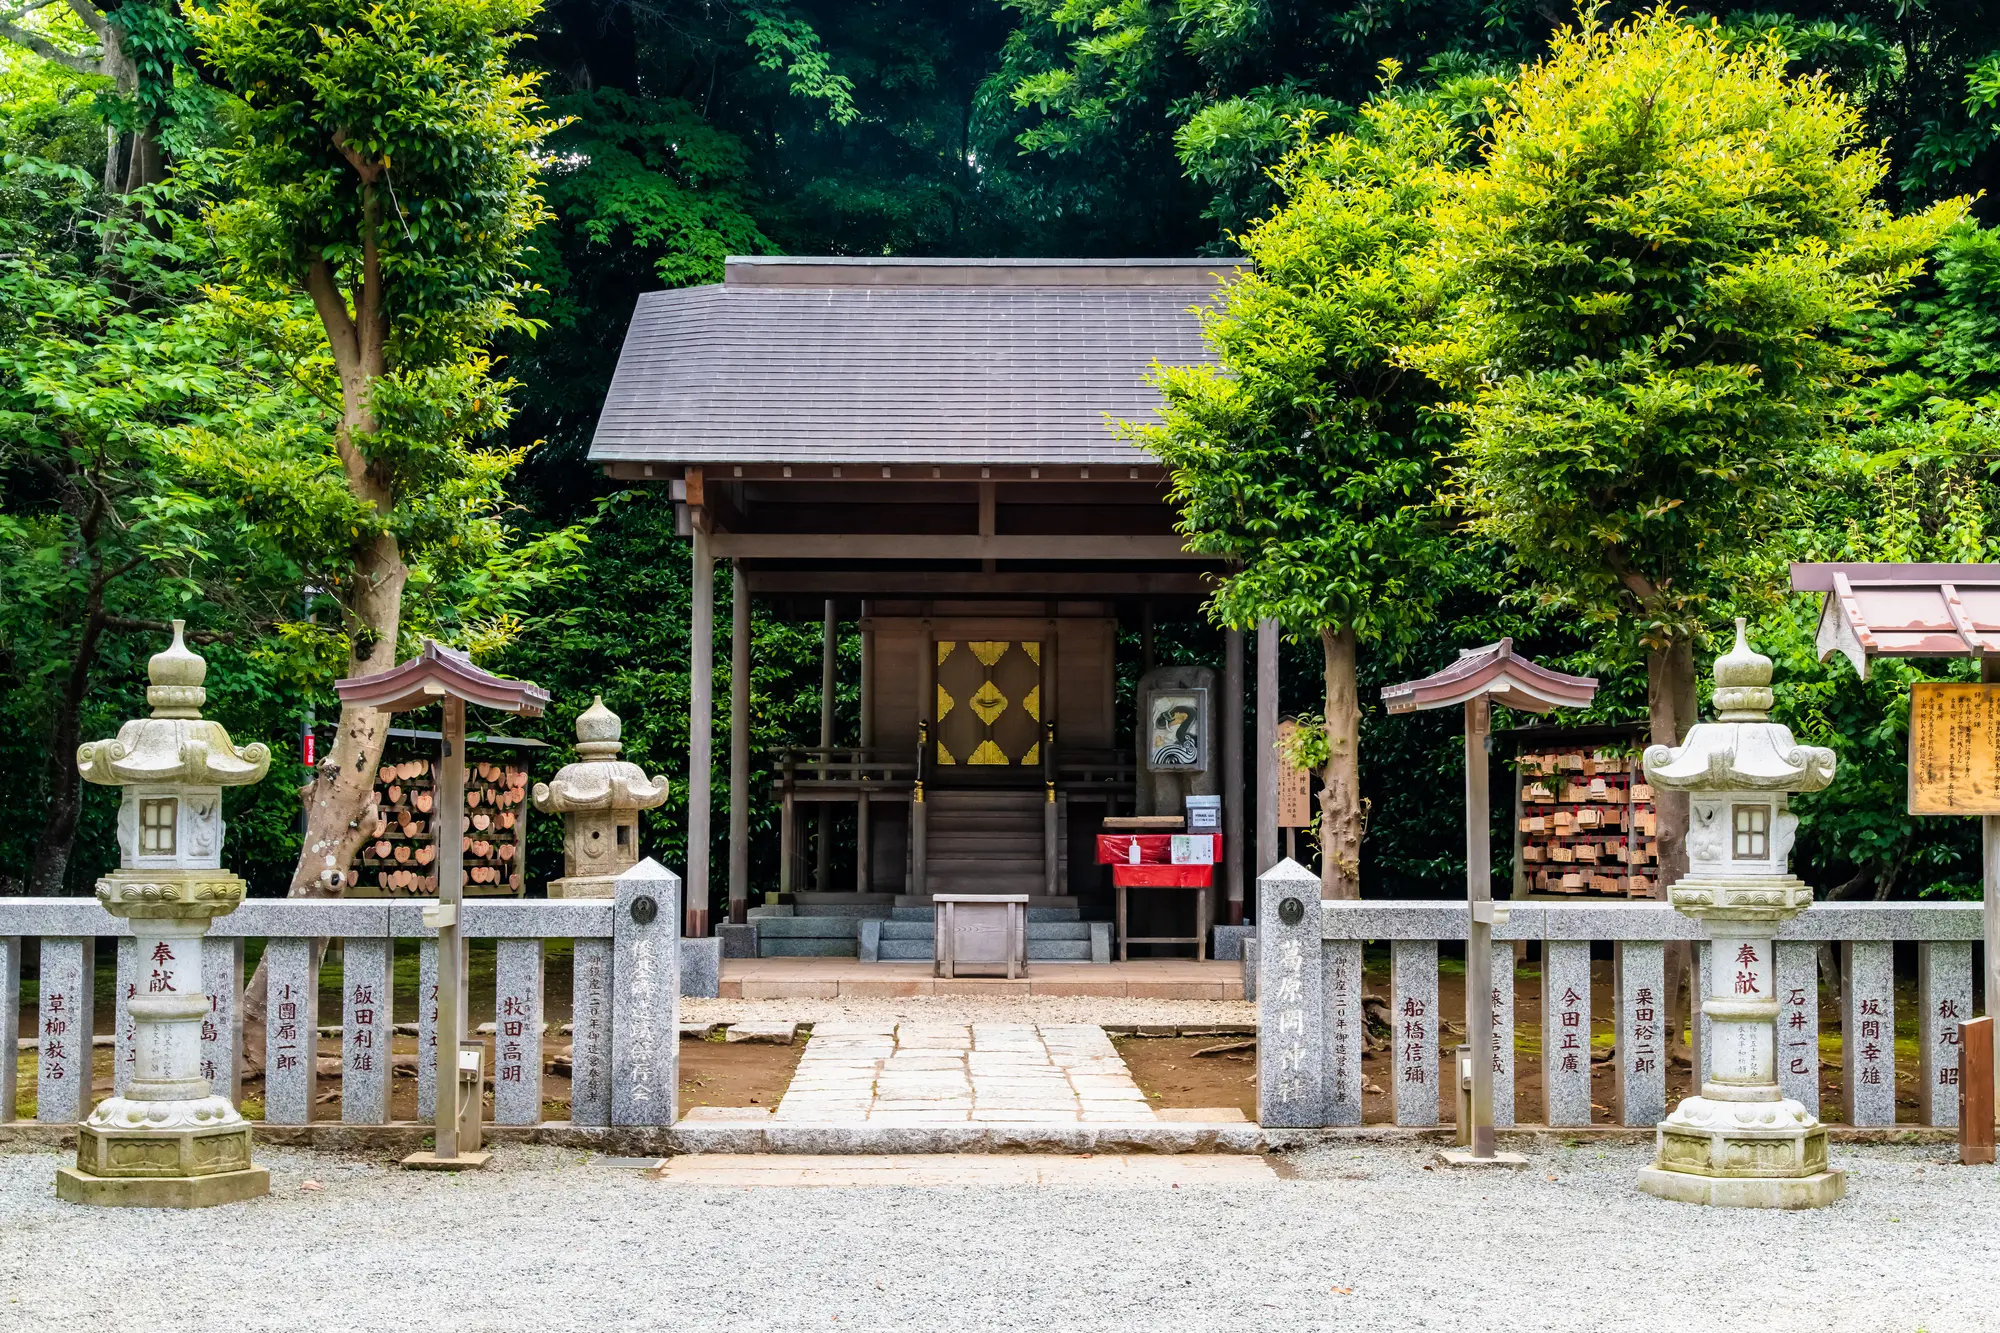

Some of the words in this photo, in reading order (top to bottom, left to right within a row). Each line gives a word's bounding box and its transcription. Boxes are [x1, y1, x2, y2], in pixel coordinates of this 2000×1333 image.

[150, 942, 177, 992] 奉献
[1734, 943, 1760, 995] 奉献
[45, 994, 67, 1080] 草柳教治
[352, 984, 375, 1072] 飯田利雄
[502, 996, 525, 1083] 牧田高明
[1278, 939, 1306, 1103] 葛原岡神社
[1633, 988, 1655, 1074] 栗田裕二郎
[1860, 999, 1882, 1085] 坂間幸雄
